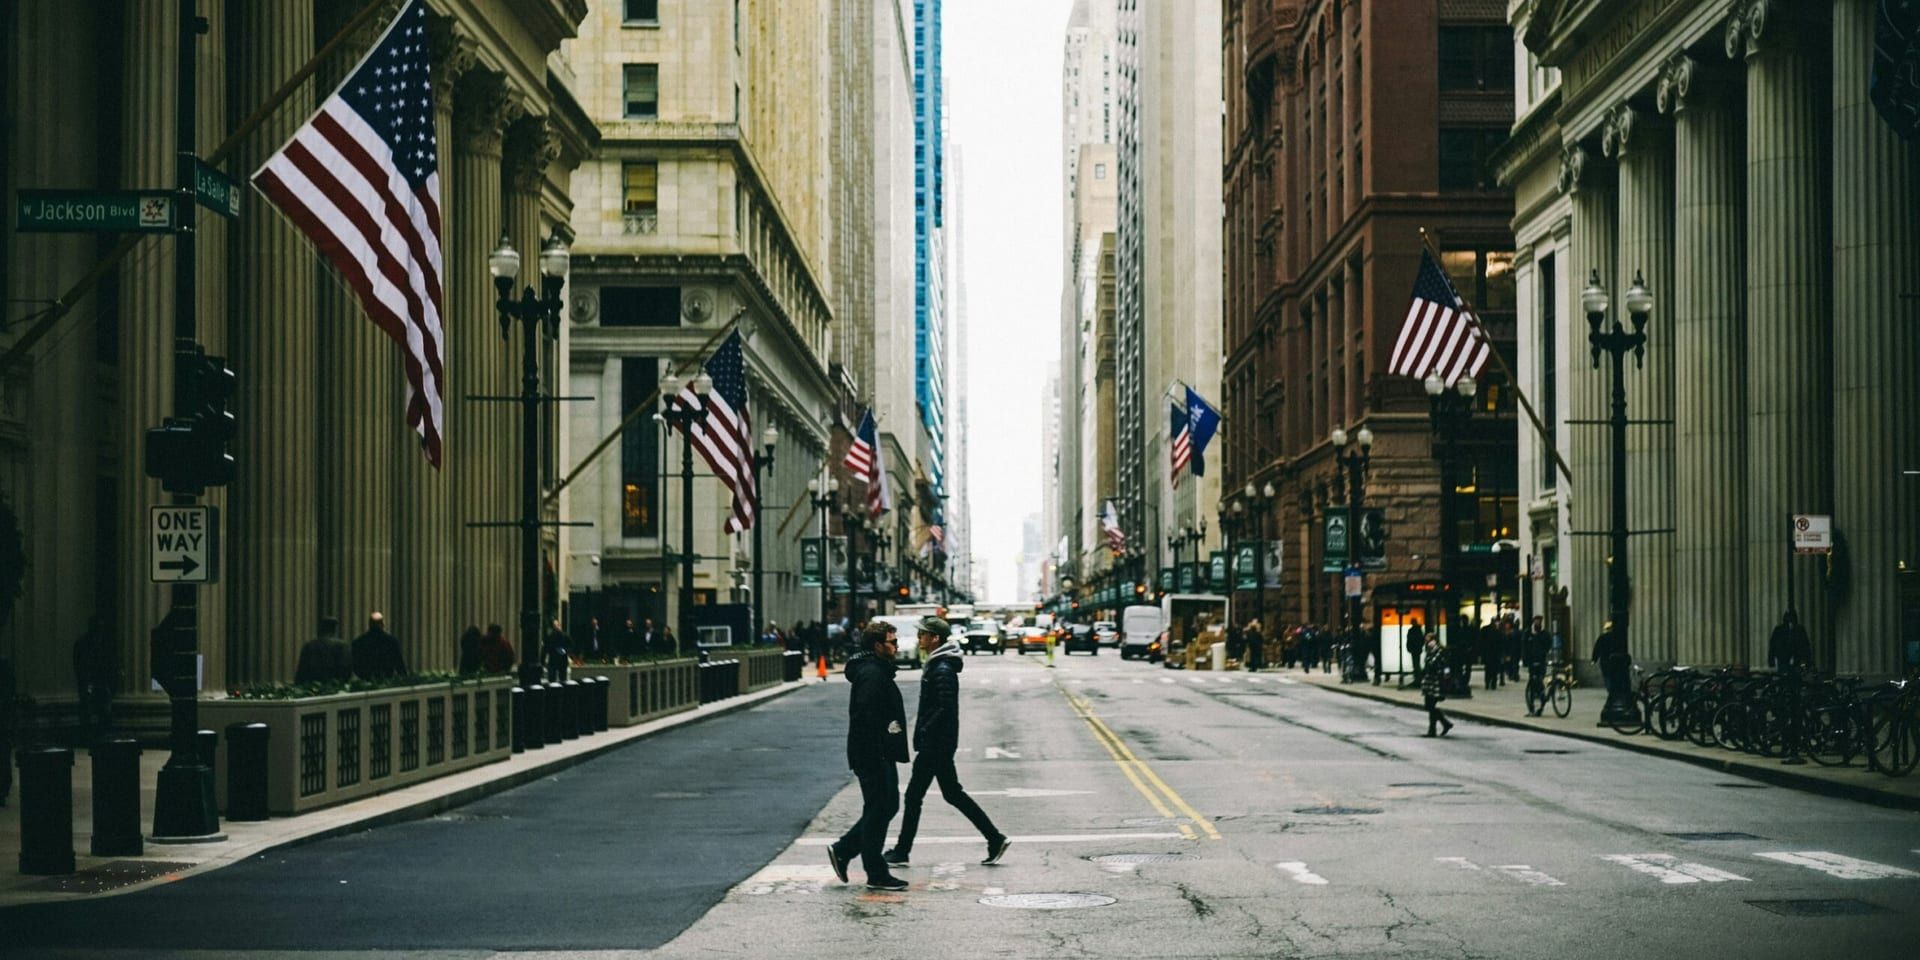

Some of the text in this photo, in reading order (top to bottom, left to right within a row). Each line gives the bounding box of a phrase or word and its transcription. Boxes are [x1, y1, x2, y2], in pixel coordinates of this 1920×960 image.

[197, 170, 206, 193] La
[23, 200, 135, 221] W Jackson Blvd
[158, 512, 201, 530] ONE
[157, 534, 203, 552] WAY
